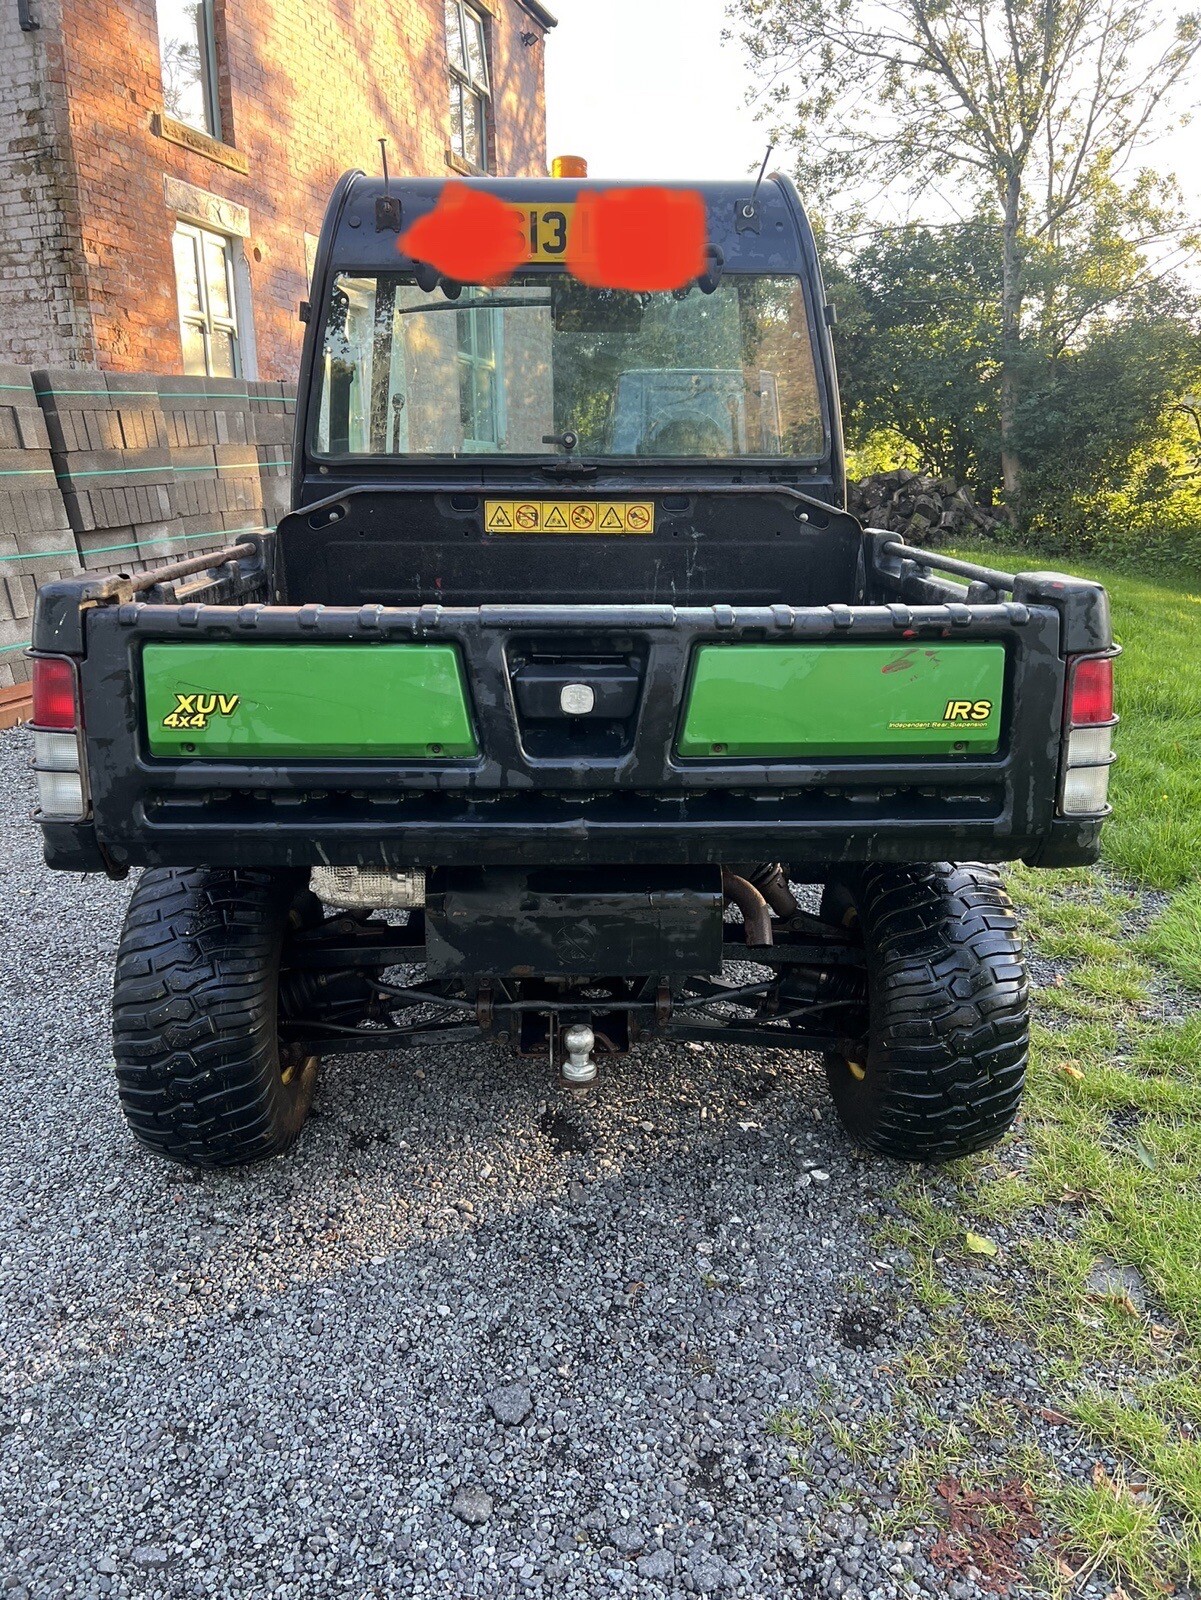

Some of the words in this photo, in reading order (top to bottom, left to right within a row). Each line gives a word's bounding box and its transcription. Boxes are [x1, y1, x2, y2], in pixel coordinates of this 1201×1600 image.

[173, 693, 240, 715] XUV
[943, 700, 992, 720] IRS
[163, 713, 206, 728] 4x4
[889, 721, 930, 730] Independent
[931, 721, 948, 729] Rear
[950, 721, 988, 730] Suspension
